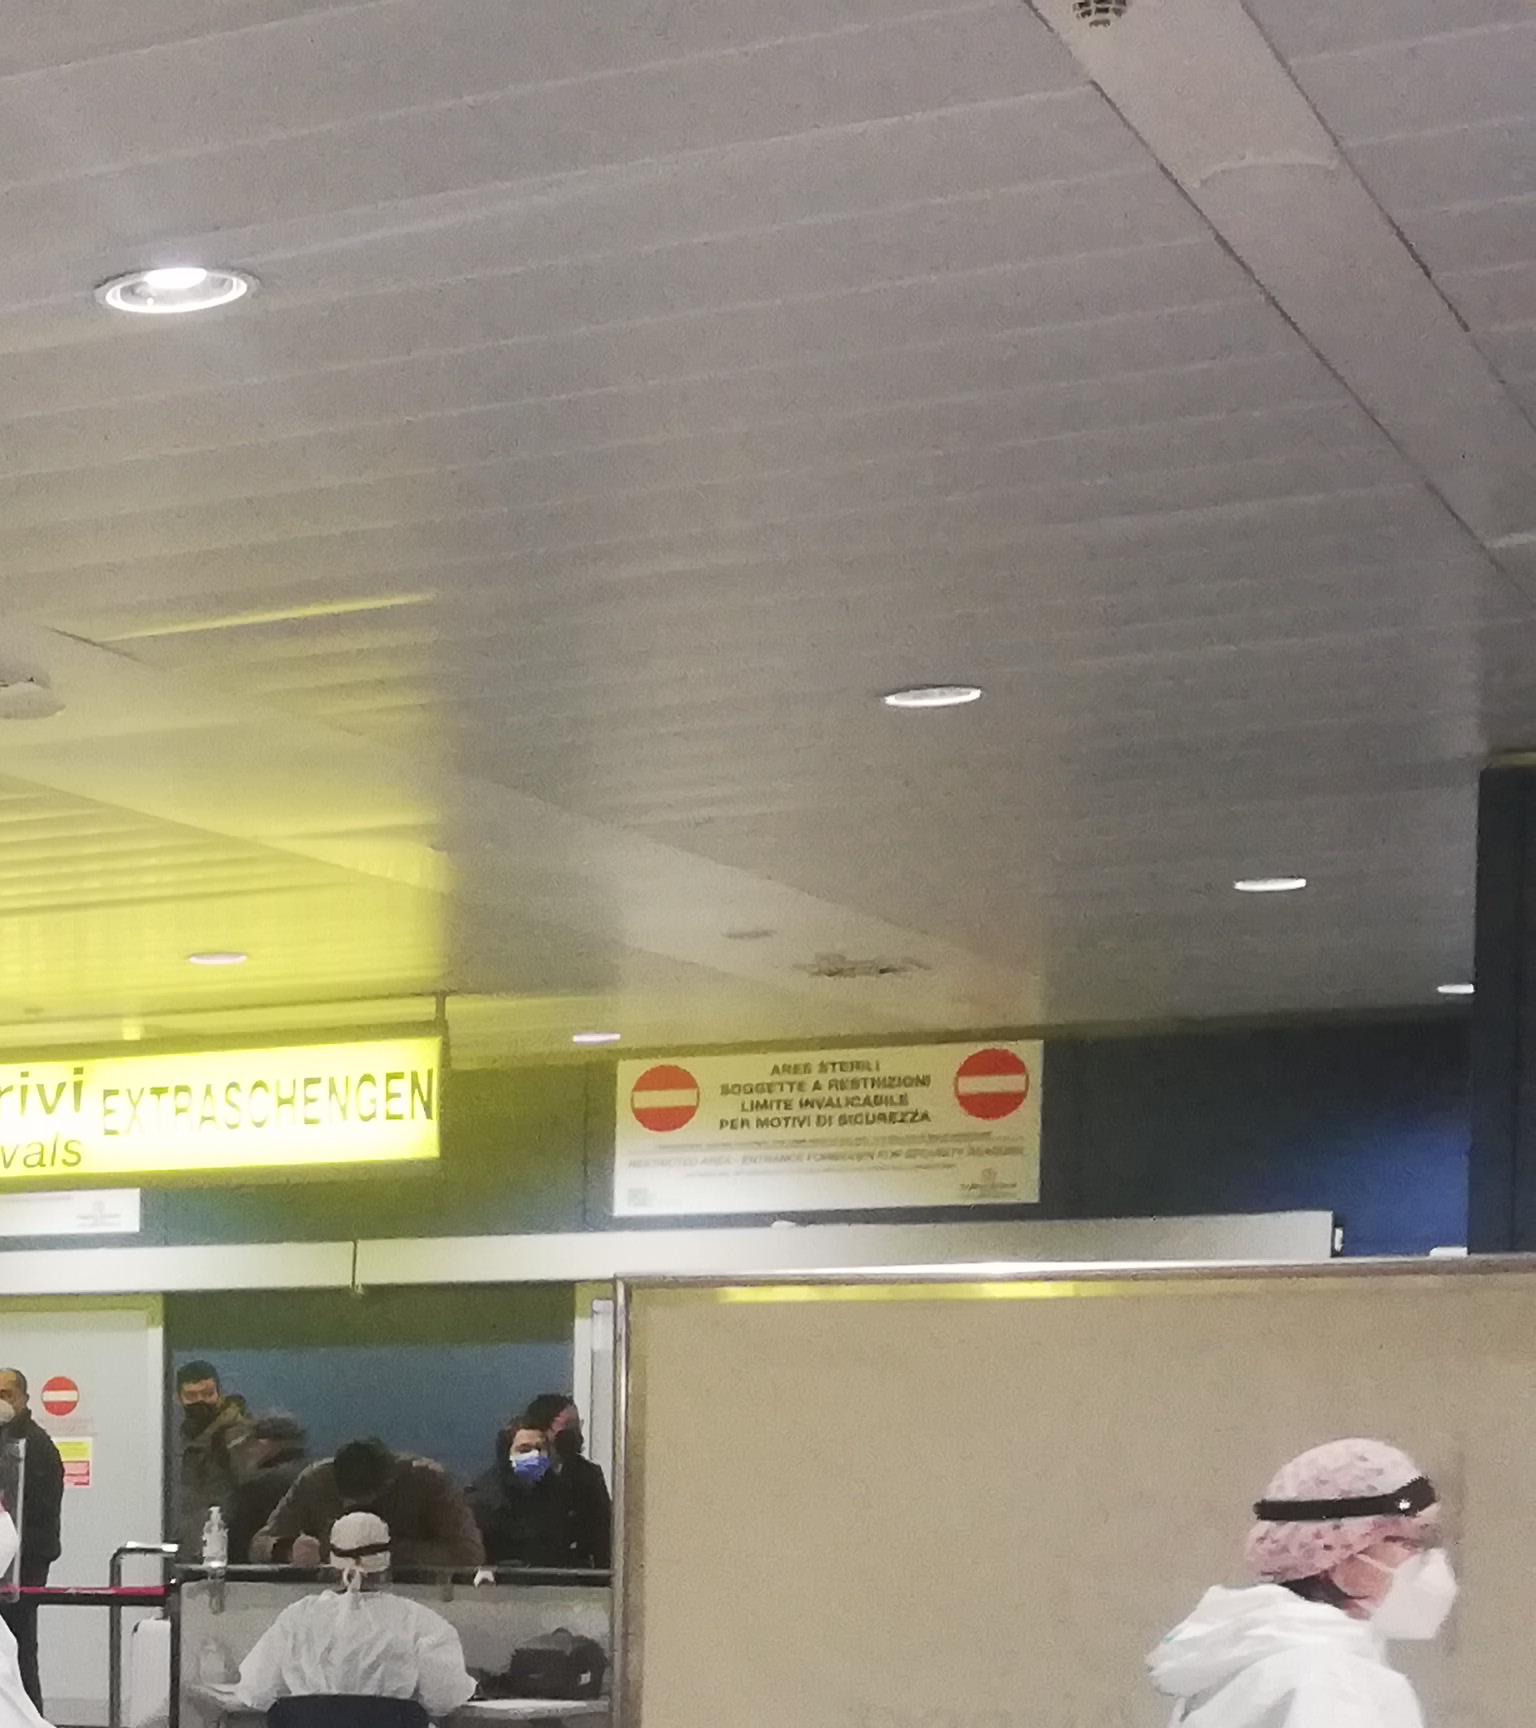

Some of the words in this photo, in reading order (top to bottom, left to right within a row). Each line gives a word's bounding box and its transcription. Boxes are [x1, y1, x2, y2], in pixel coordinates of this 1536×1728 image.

[812, 1079, 823, 1092] A
[102, 1067, 434, 1136] EXTRASCHENGEN
[740, 1098, 794, 1112] LIMITE
[719, 1117, 750, 1130] PER
[756, 1115, 811, 1129] MOTIVI
[816, 1114, 832, 1128] DI
